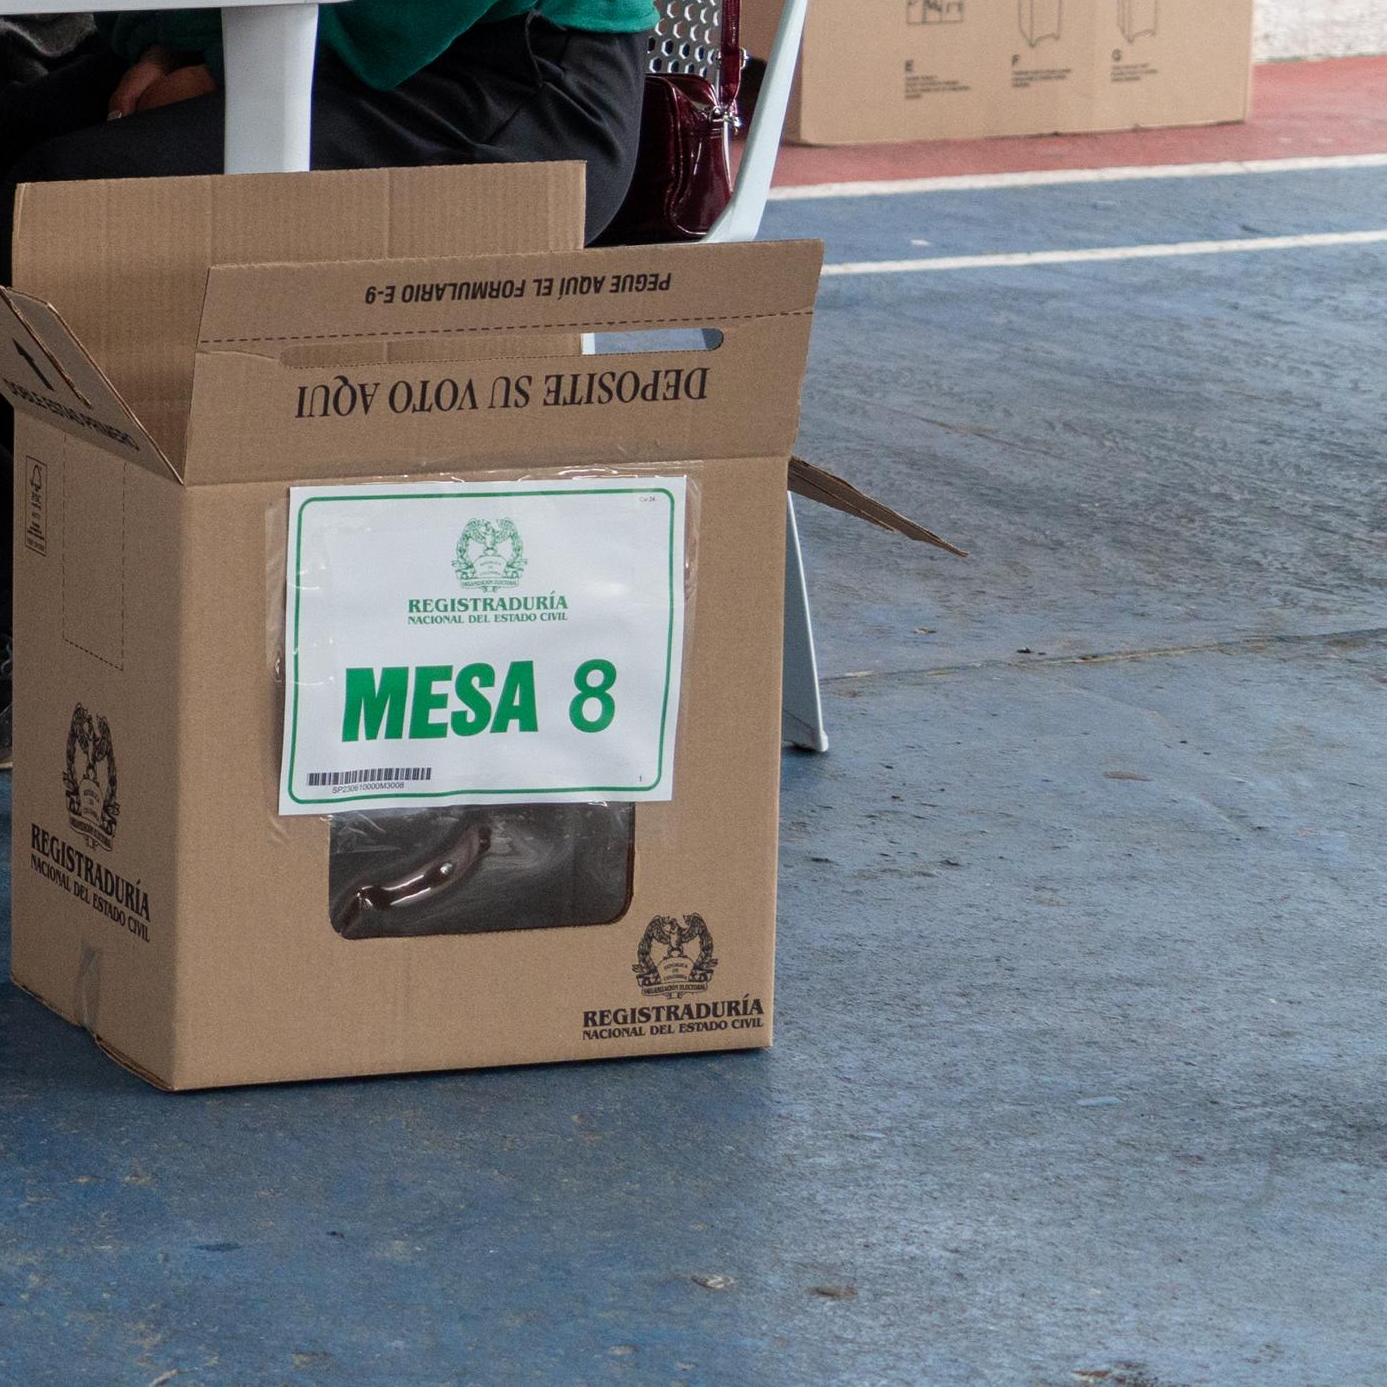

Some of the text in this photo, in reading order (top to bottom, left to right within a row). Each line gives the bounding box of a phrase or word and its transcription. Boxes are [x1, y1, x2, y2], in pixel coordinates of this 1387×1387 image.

[905, 60, 914, 72] E
[1012, 54, 1020, 66] F
[1112, 49, 1122, 61] G
[365, 272, 672, 304] PEGUE AQUÍ EL FORMULARIO E-9
[388, 378, 479, 414] VOTO
[487, 375, 533, 409] SU
[543, 367, 710, 407] DEPOSITE
[408, 590, 568, 613] REGISTRADURÍA
[408, 612, 568, 625] NACIONAL DEL ESTADO CIVIL
[341, 658, 617, 743] MESA 8
[31, 823, 151, 922] REGISTRADURÍA
[31, 853, 150, 942] NACIONAL DEL ESTADO CIVIL
[583, 993, 764, 1027] REGISTRADURÍA
[582, 1018, 763, 1040] NACIONAL DEL ESTADO CIVIL
